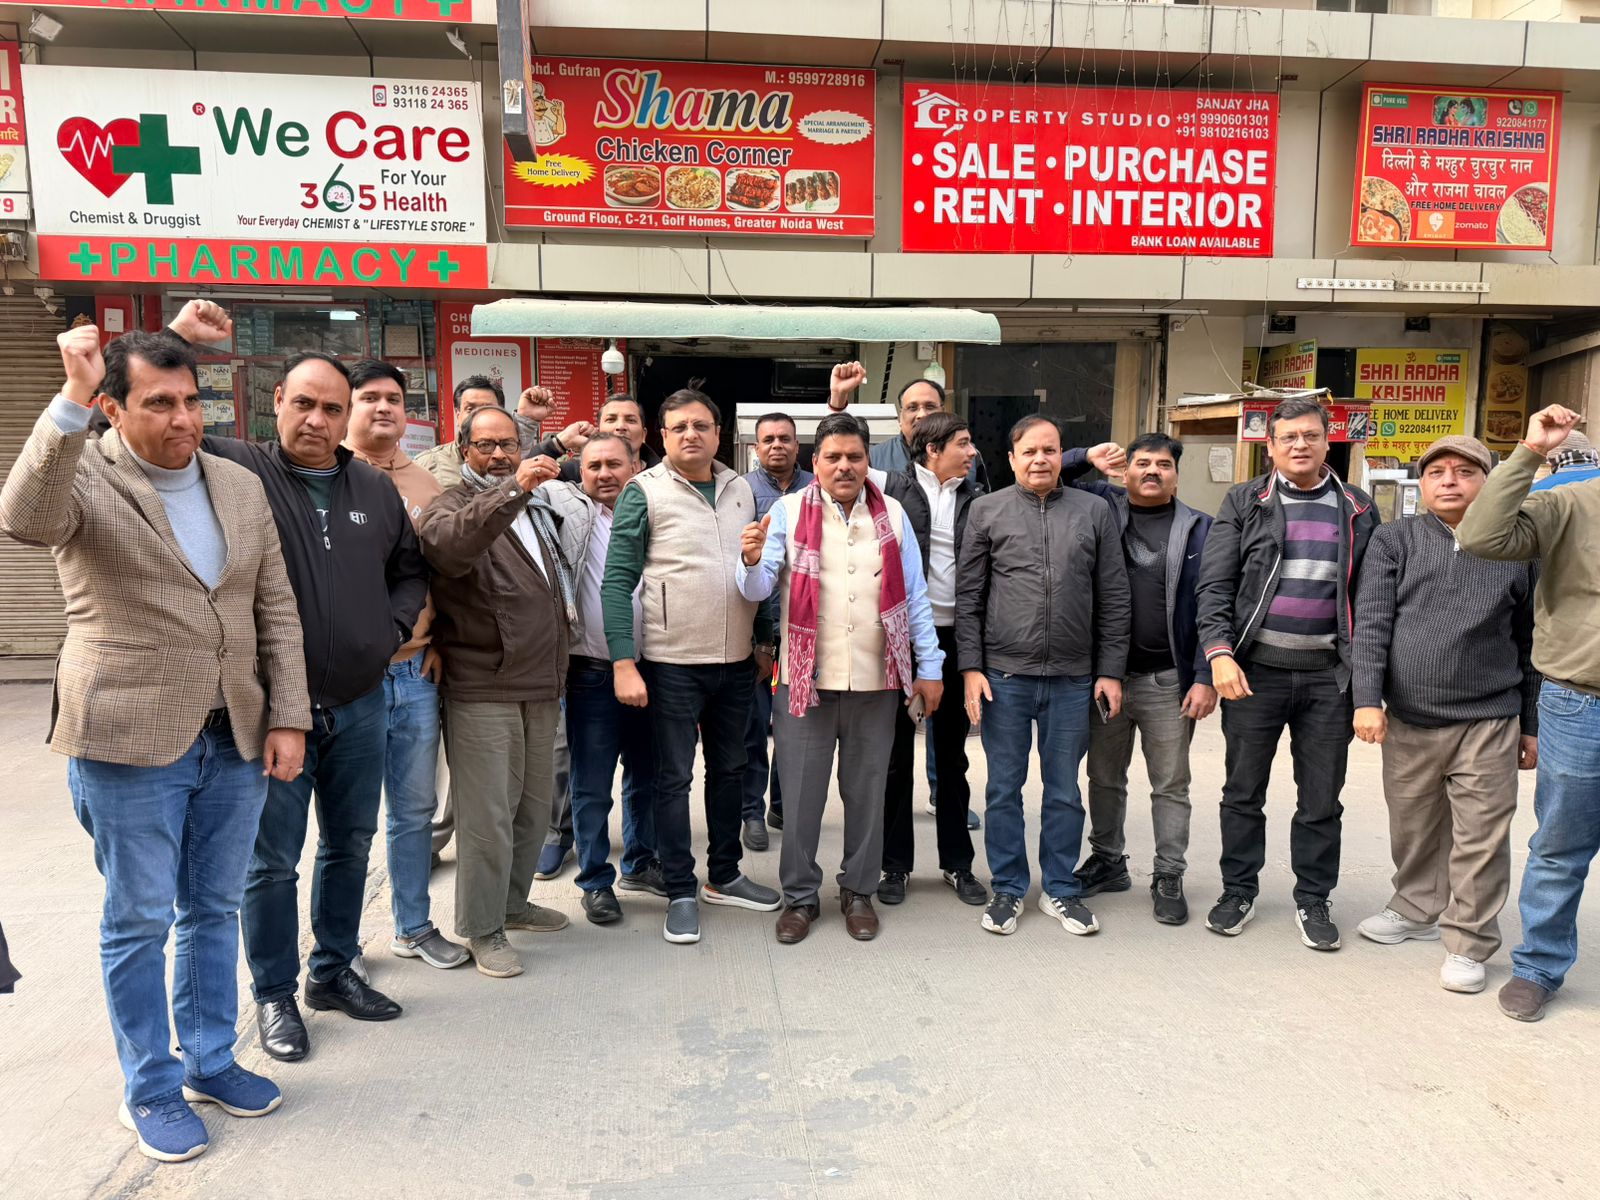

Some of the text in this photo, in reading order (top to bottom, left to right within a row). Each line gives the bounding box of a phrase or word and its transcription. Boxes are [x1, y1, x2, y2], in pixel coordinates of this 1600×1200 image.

[531, 63, 601, 77] ohd. Gufran
[765, 71, 865, 87] M.: 9599728916
[393, 85, 468, 97] 93116 24365
[393, 98, 468, 110] 93118 24 365
[593, 68, 793, 134] Shama
[1196, 98, 1270, 111] SANJAY JHA
[937, 108, 1171, 127] PROPERTY STUDIO
[1176, 113, 1269, 126] +91 9990601301
[1496, 117, 1547, 129] 9220841177
[212, 106, 470, 163] We Care
[1175, 126, 1269, 139] +91 9810216103
[1372, 125, 1546, 149] SHRI RADHA KRISHNA
[596, 136, 793, 167] Chicken Corner
[545, 160, 562, 168] Free
[932, 142, 1268, 185] SALE PURCHASE
[1381, 147, 1416, 170] दिल्ली
[1420, 151, 1431, 170] के
[1470, 157, 1506, 180] चुरचुर
[1510, 159, 1534, 174] नान
[381, 169, 446, 186] For Your
[527, 168, 580, 178] Home Delivery
[300, 163, 377, 213] 365
[1405, 173, 1508, 199] और राजमा चावल
[334, 191, 344, 200] 24
[383, 191, 447, 212] Health
[933, 187, 1263, 228] RENT INTERIOR
[1410, 201, 1501, 211] FREE HOME DELIVERY
[69, 210, 201, 229] Chemist & Druggist
[237, 214, 257, 226] Your
[258, 215, 299, 229] Everyday
[302, 217, 350, 230] CHEMIST
[353, 218, 360, 229] &
[543, 211, 844, 230] Ground Floor, C-21, Golf Homes, Greater Noida West
[1455, 222, 1489, 230] zomato
[1131, 235, 1260, 249] BANK LOAN AVAILABLE
[109, 242, 417, 282] PHARMACY
[454, 347, 517, 357] MEDICINES
[1263, 359, 1282, 377] SHRI
[1284, 353, 1314, 373] RADHA
[1360, 363, 1460, 381] SHRI RADHA
[1372, 385, 1446, 402] KRISHNA
[1369, 409, 1459, 421] EE HOME DELIVERY
[1328, 421, 1346, 435] लूदा
[1399, 424, 1452, 434] 9220841177
[1382, 438, 1390, 449] के
